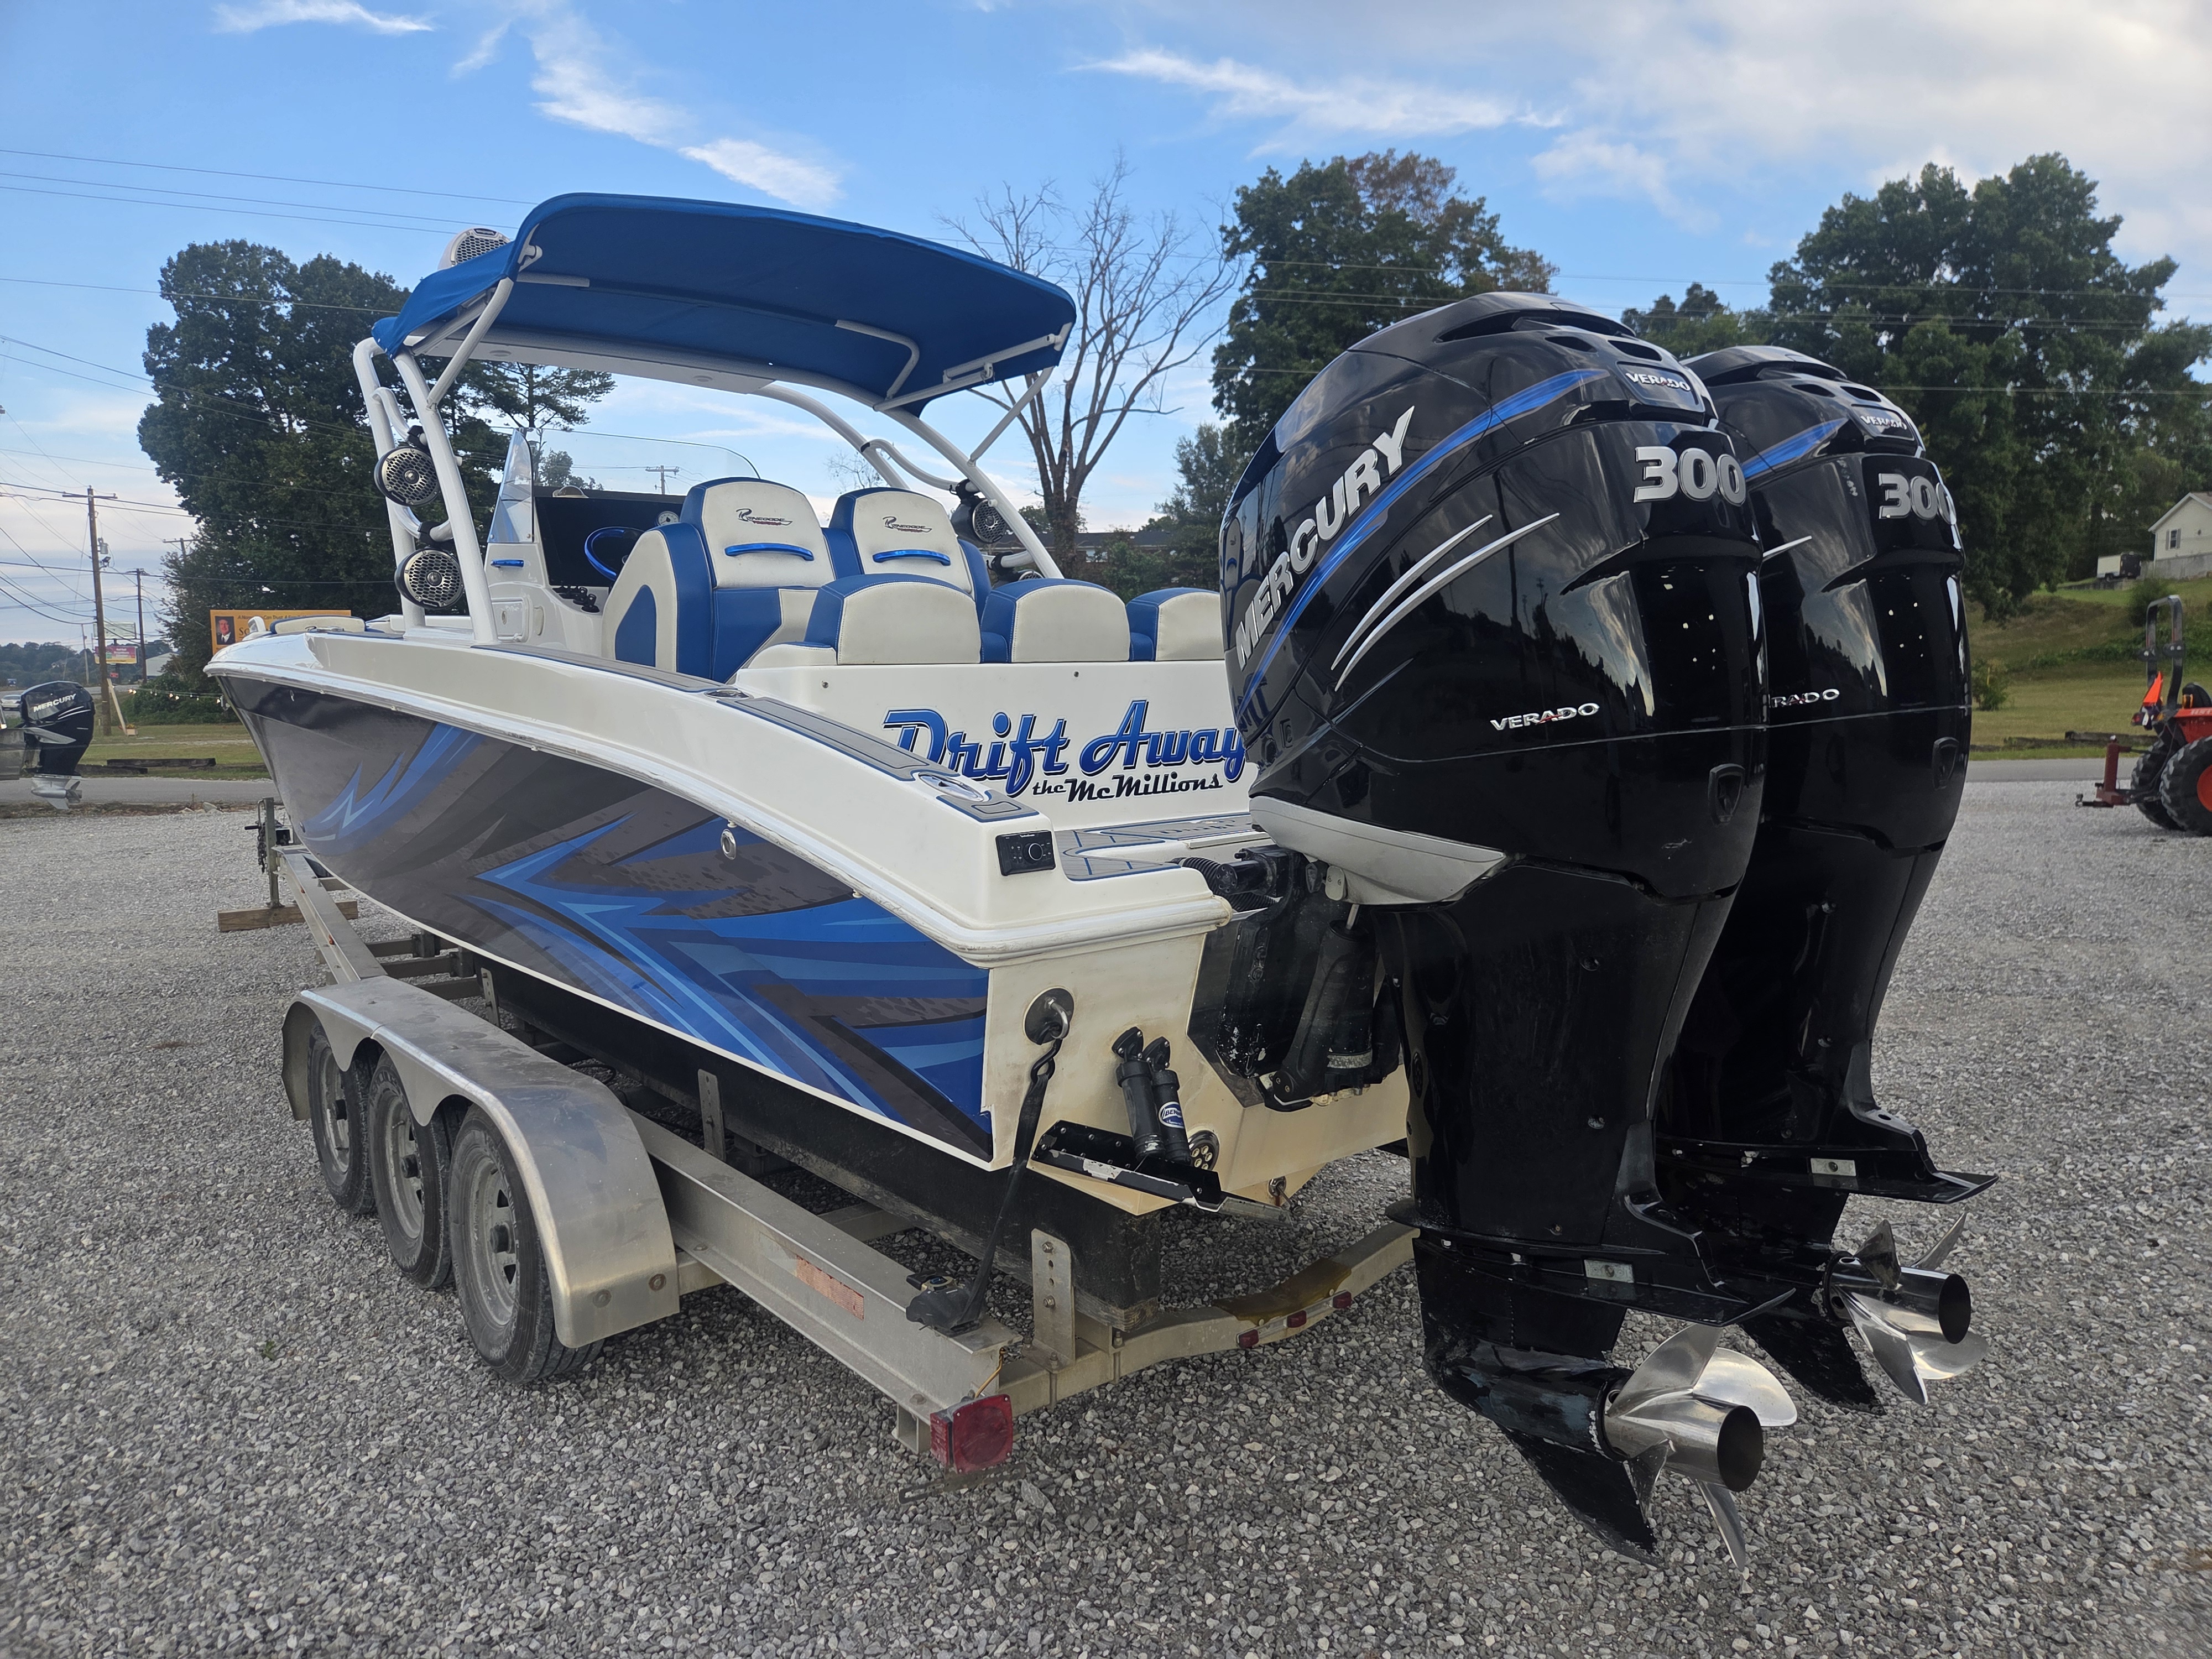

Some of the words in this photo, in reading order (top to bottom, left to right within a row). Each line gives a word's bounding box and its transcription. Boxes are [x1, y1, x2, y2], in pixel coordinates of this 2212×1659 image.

[1625, 373, 1691, 392] VERADO
[1860, 415, 1907, 430] VERADO
[1633, 446, 1746, 507] 300
[1878, 473, 1957, 525] 300
[1235, 405, 1415, 671] MERCURY
[33, 693, 76, 713] MERCURY
[1768, 688, 1840, 708] RADO
[1490, 702, 1600, 731] VERADO
[883, 706, 1071, 798] Drift
[1079, 699, 1246, 784] Away
[1032, 780, 1065, 795] the
